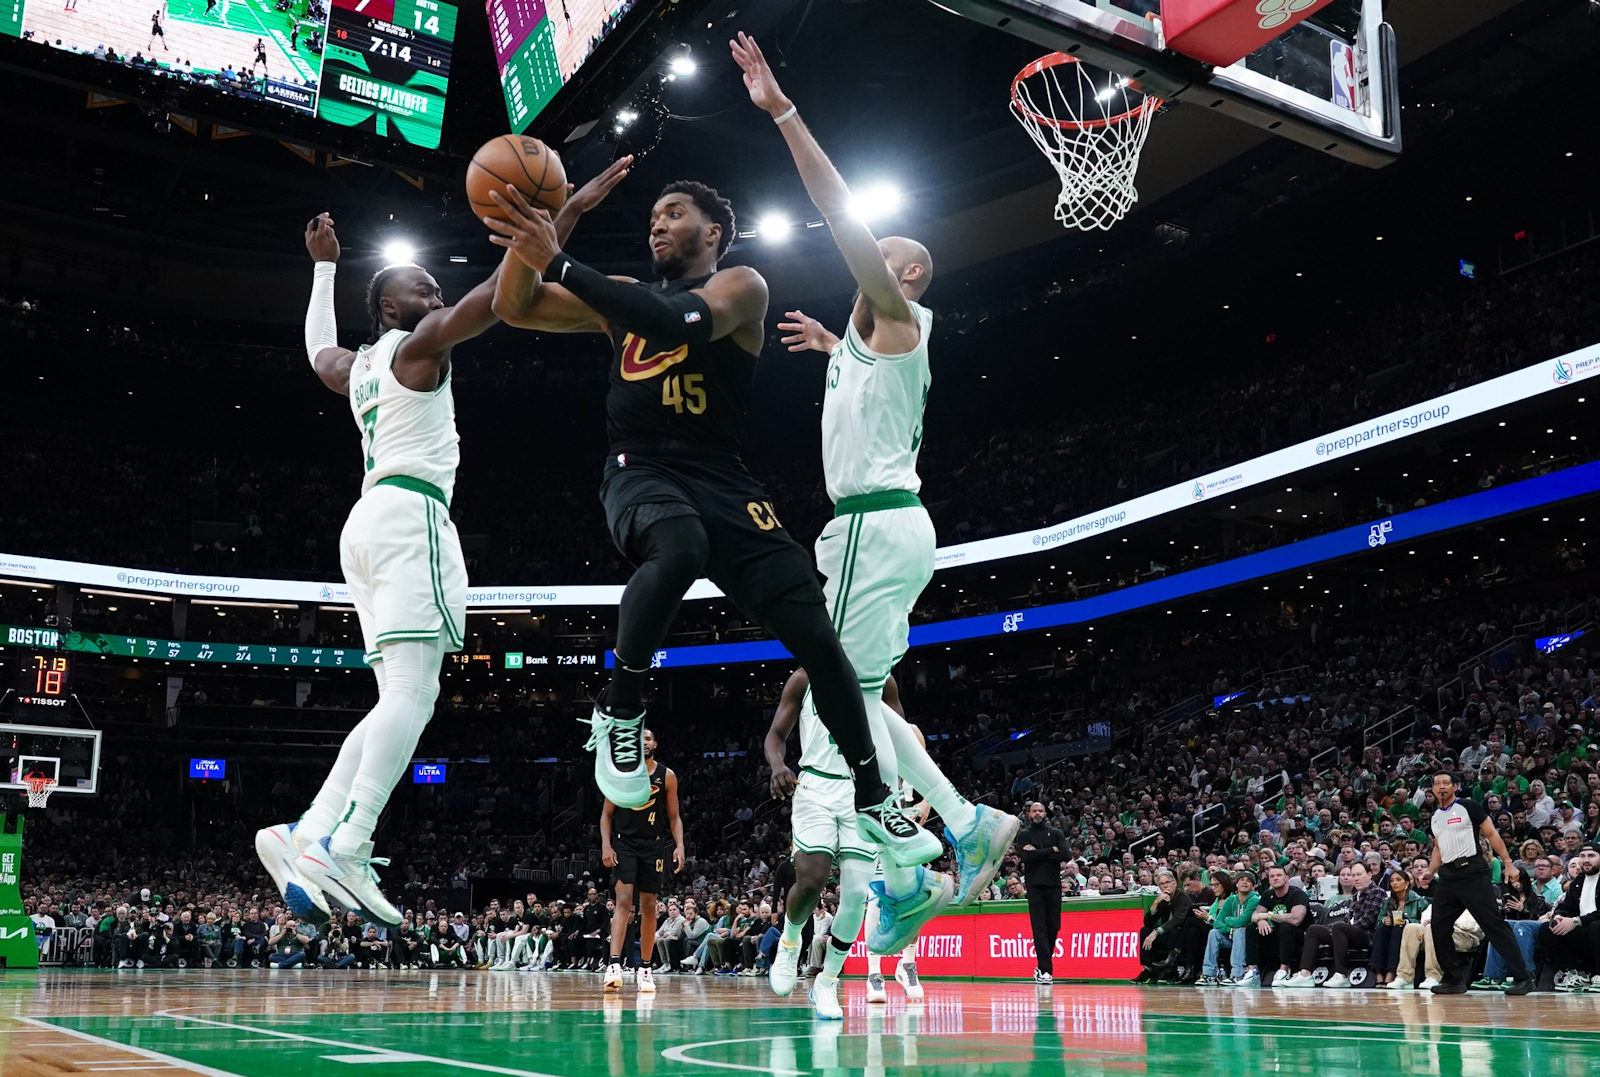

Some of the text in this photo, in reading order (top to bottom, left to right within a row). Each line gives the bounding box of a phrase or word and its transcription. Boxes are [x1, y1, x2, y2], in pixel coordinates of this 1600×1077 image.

[414, 10, 440, 35] 14
[336, 29, 348, 40] 18
[369, 35, 412, 62] 7:14
[427, 55, 441, 68] 1st
[339, 73, 428, 113] CELTICS PLAYOFFS
[354, 377, 380, 408] BROWN
[661, 373, 707, 415] 45
[1315, 403, 1451, 456] @preppartnersgroup
[1032, 510, 1127, 546] @preppartnersgroup
[117, 572, 240, 593] @preppartnersgroup
[466, 592, 557, 602] eppartnersgroup
[8, 627, 59, 646] BOSTON
[34, 655, 67, 671] 7:13
[130, 645, 342, 665] 1 7 57 4/7 2/4 1 0 4 5
[507, 655, 549, 665] TD Bank
[556, 655, 596, 665] 7:24 PM
[36, 670, 61, 694] 18
[31, 697, 66, 706] TISSOT
[647, 811, 656, 826] 4
[2, 853, 15, 863] GET
[2, 863, 14, 873] THE
[4, 873, 16, 885] App
[927, 935, 963, 957] BETTER
[1070, 933, 1091, 958] FLY
[1093, 932, 1138, 958] BETTER
